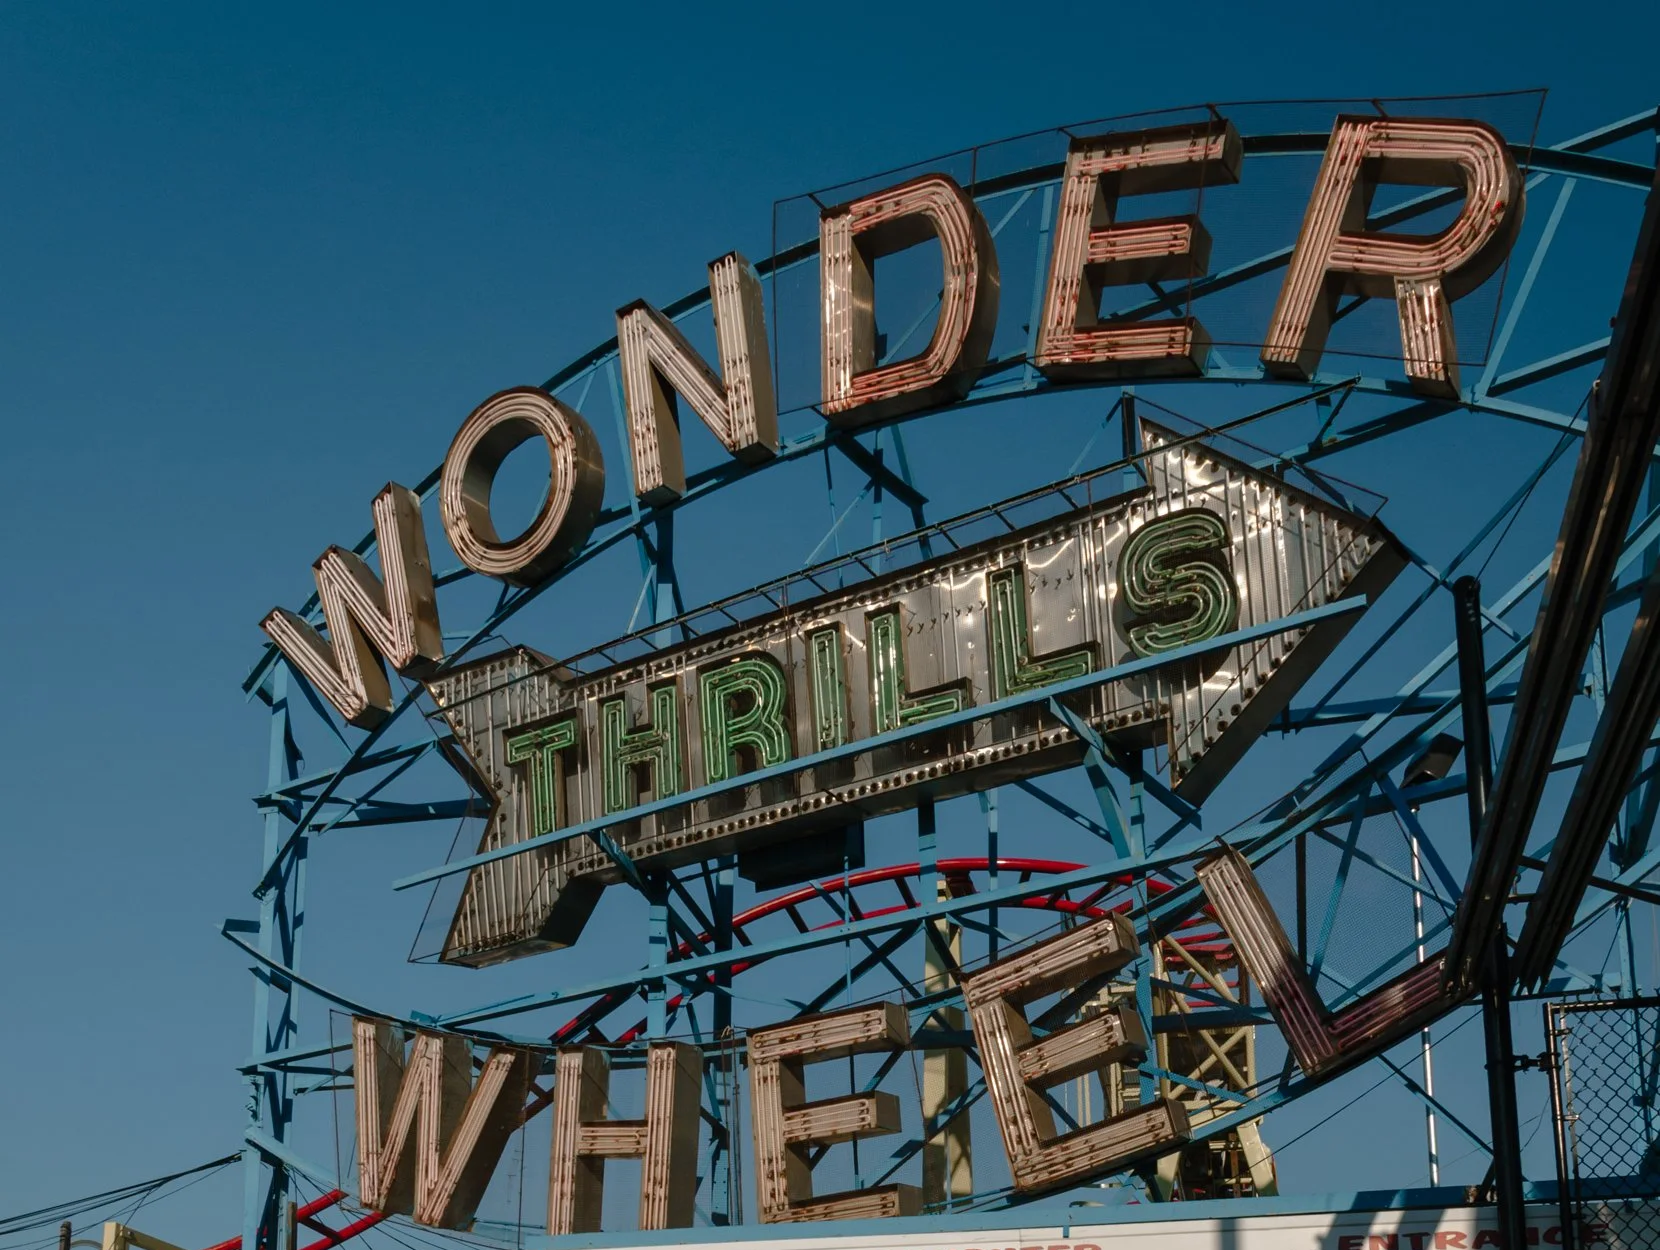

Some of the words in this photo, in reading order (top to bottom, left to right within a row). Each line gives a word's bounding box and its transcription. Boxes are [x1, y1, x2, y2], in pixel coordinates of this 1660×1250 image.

[258, 113, 1525, 730] WONDER
[503, 507, 1241, 836] THRILLS
[352, 845, 1450, 1235] WHEEL
